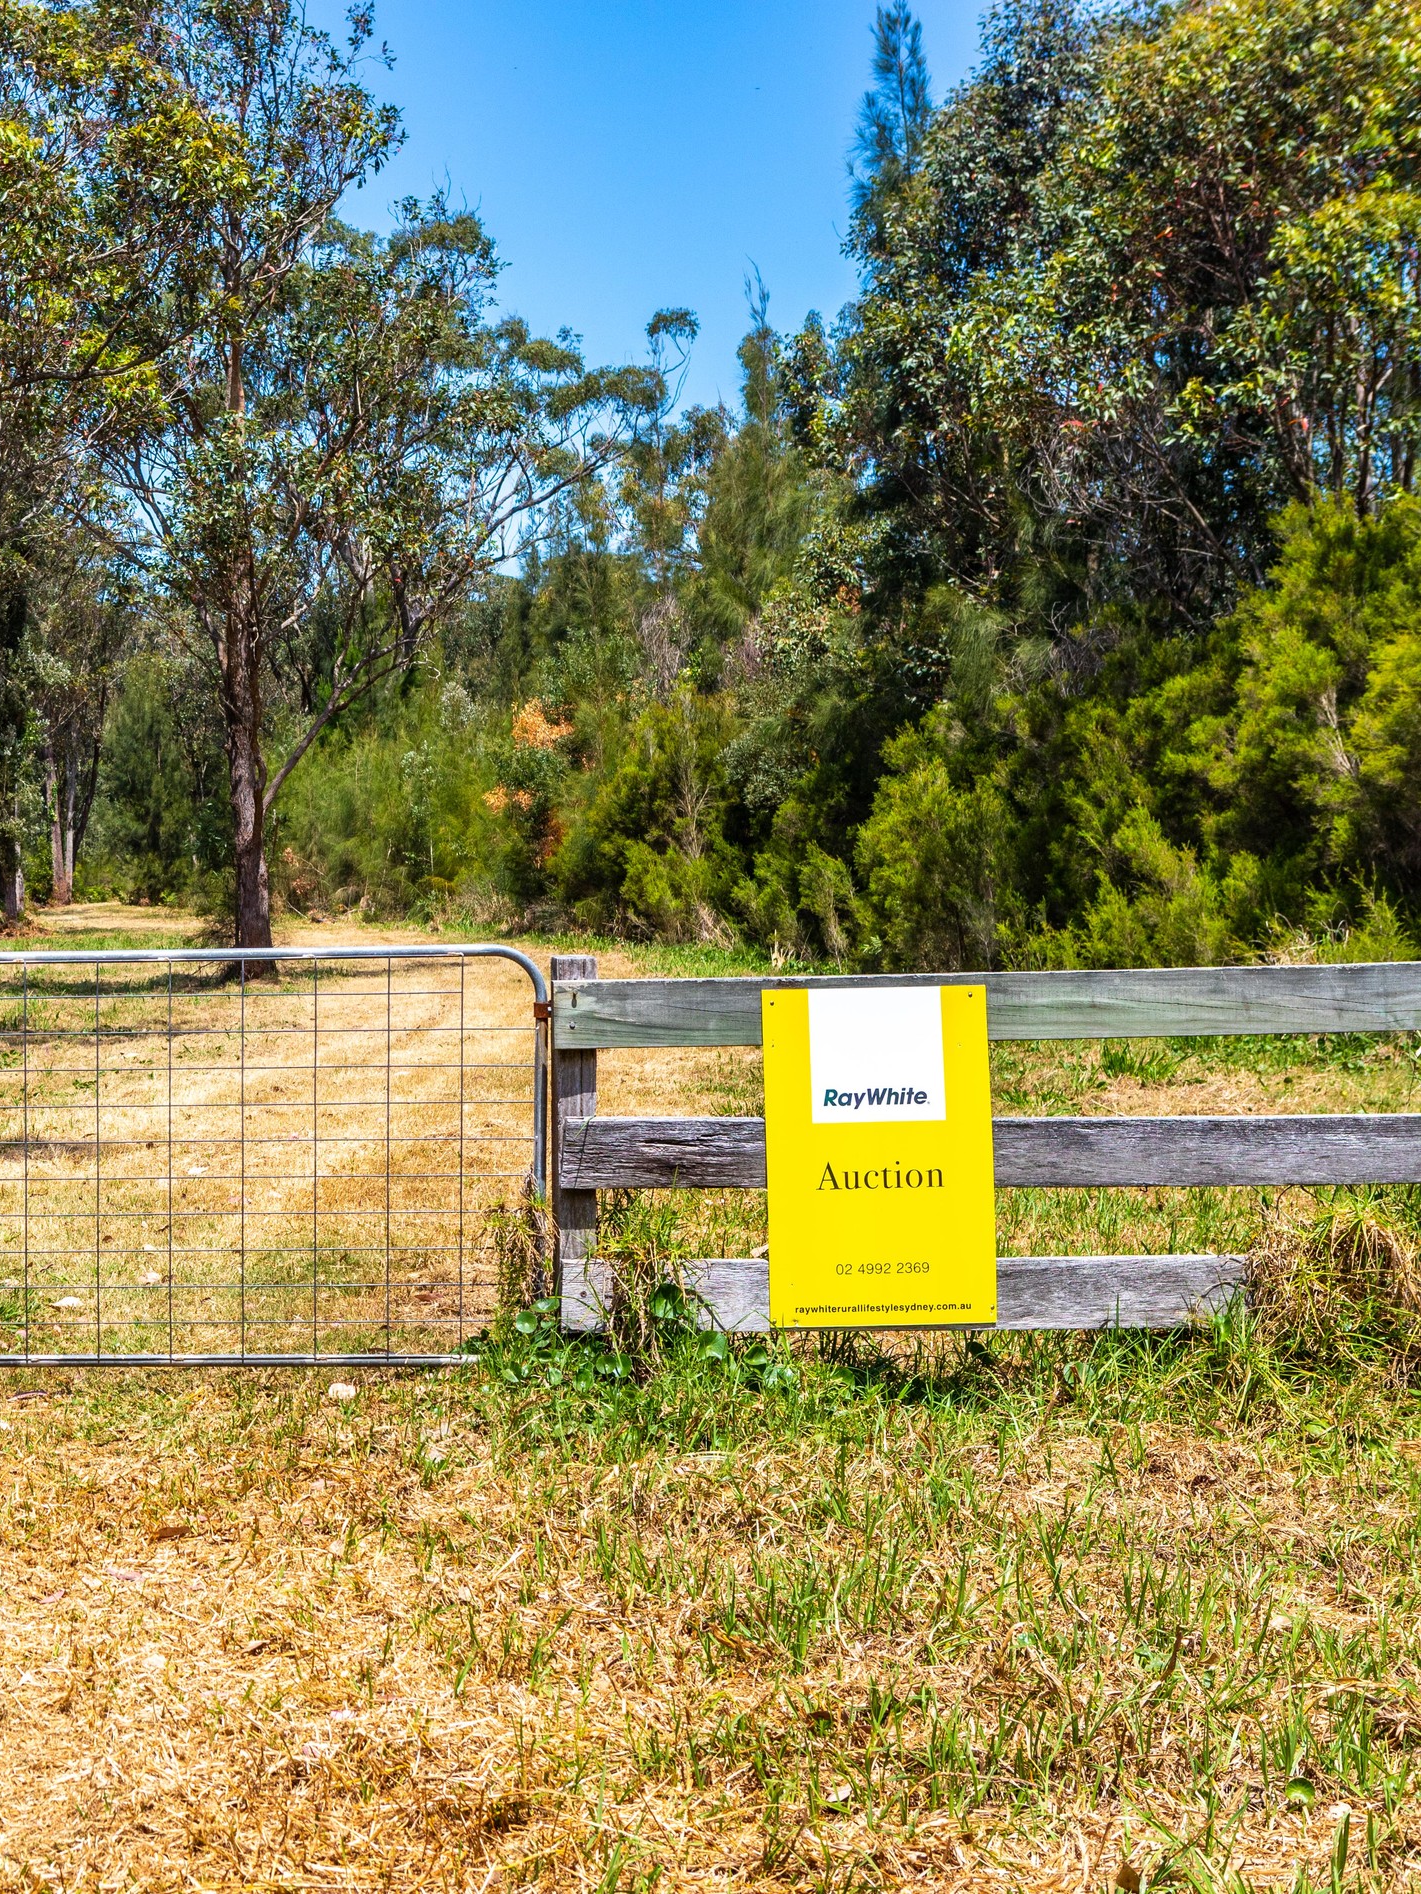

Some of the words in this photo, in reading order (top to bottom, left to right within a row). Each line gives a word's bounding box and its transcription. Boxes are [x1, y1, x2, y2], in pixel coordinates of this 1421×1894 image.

[815, 1160, 945, 1191] Auction
[835, 1263, 853, 1276] 02
[857, 1262, 892, 1275] 4992
[896, 1261, 930, 1274] 2369
[795, 1302, 972, 1315] raywhiterurallifestylesydney.com.au
